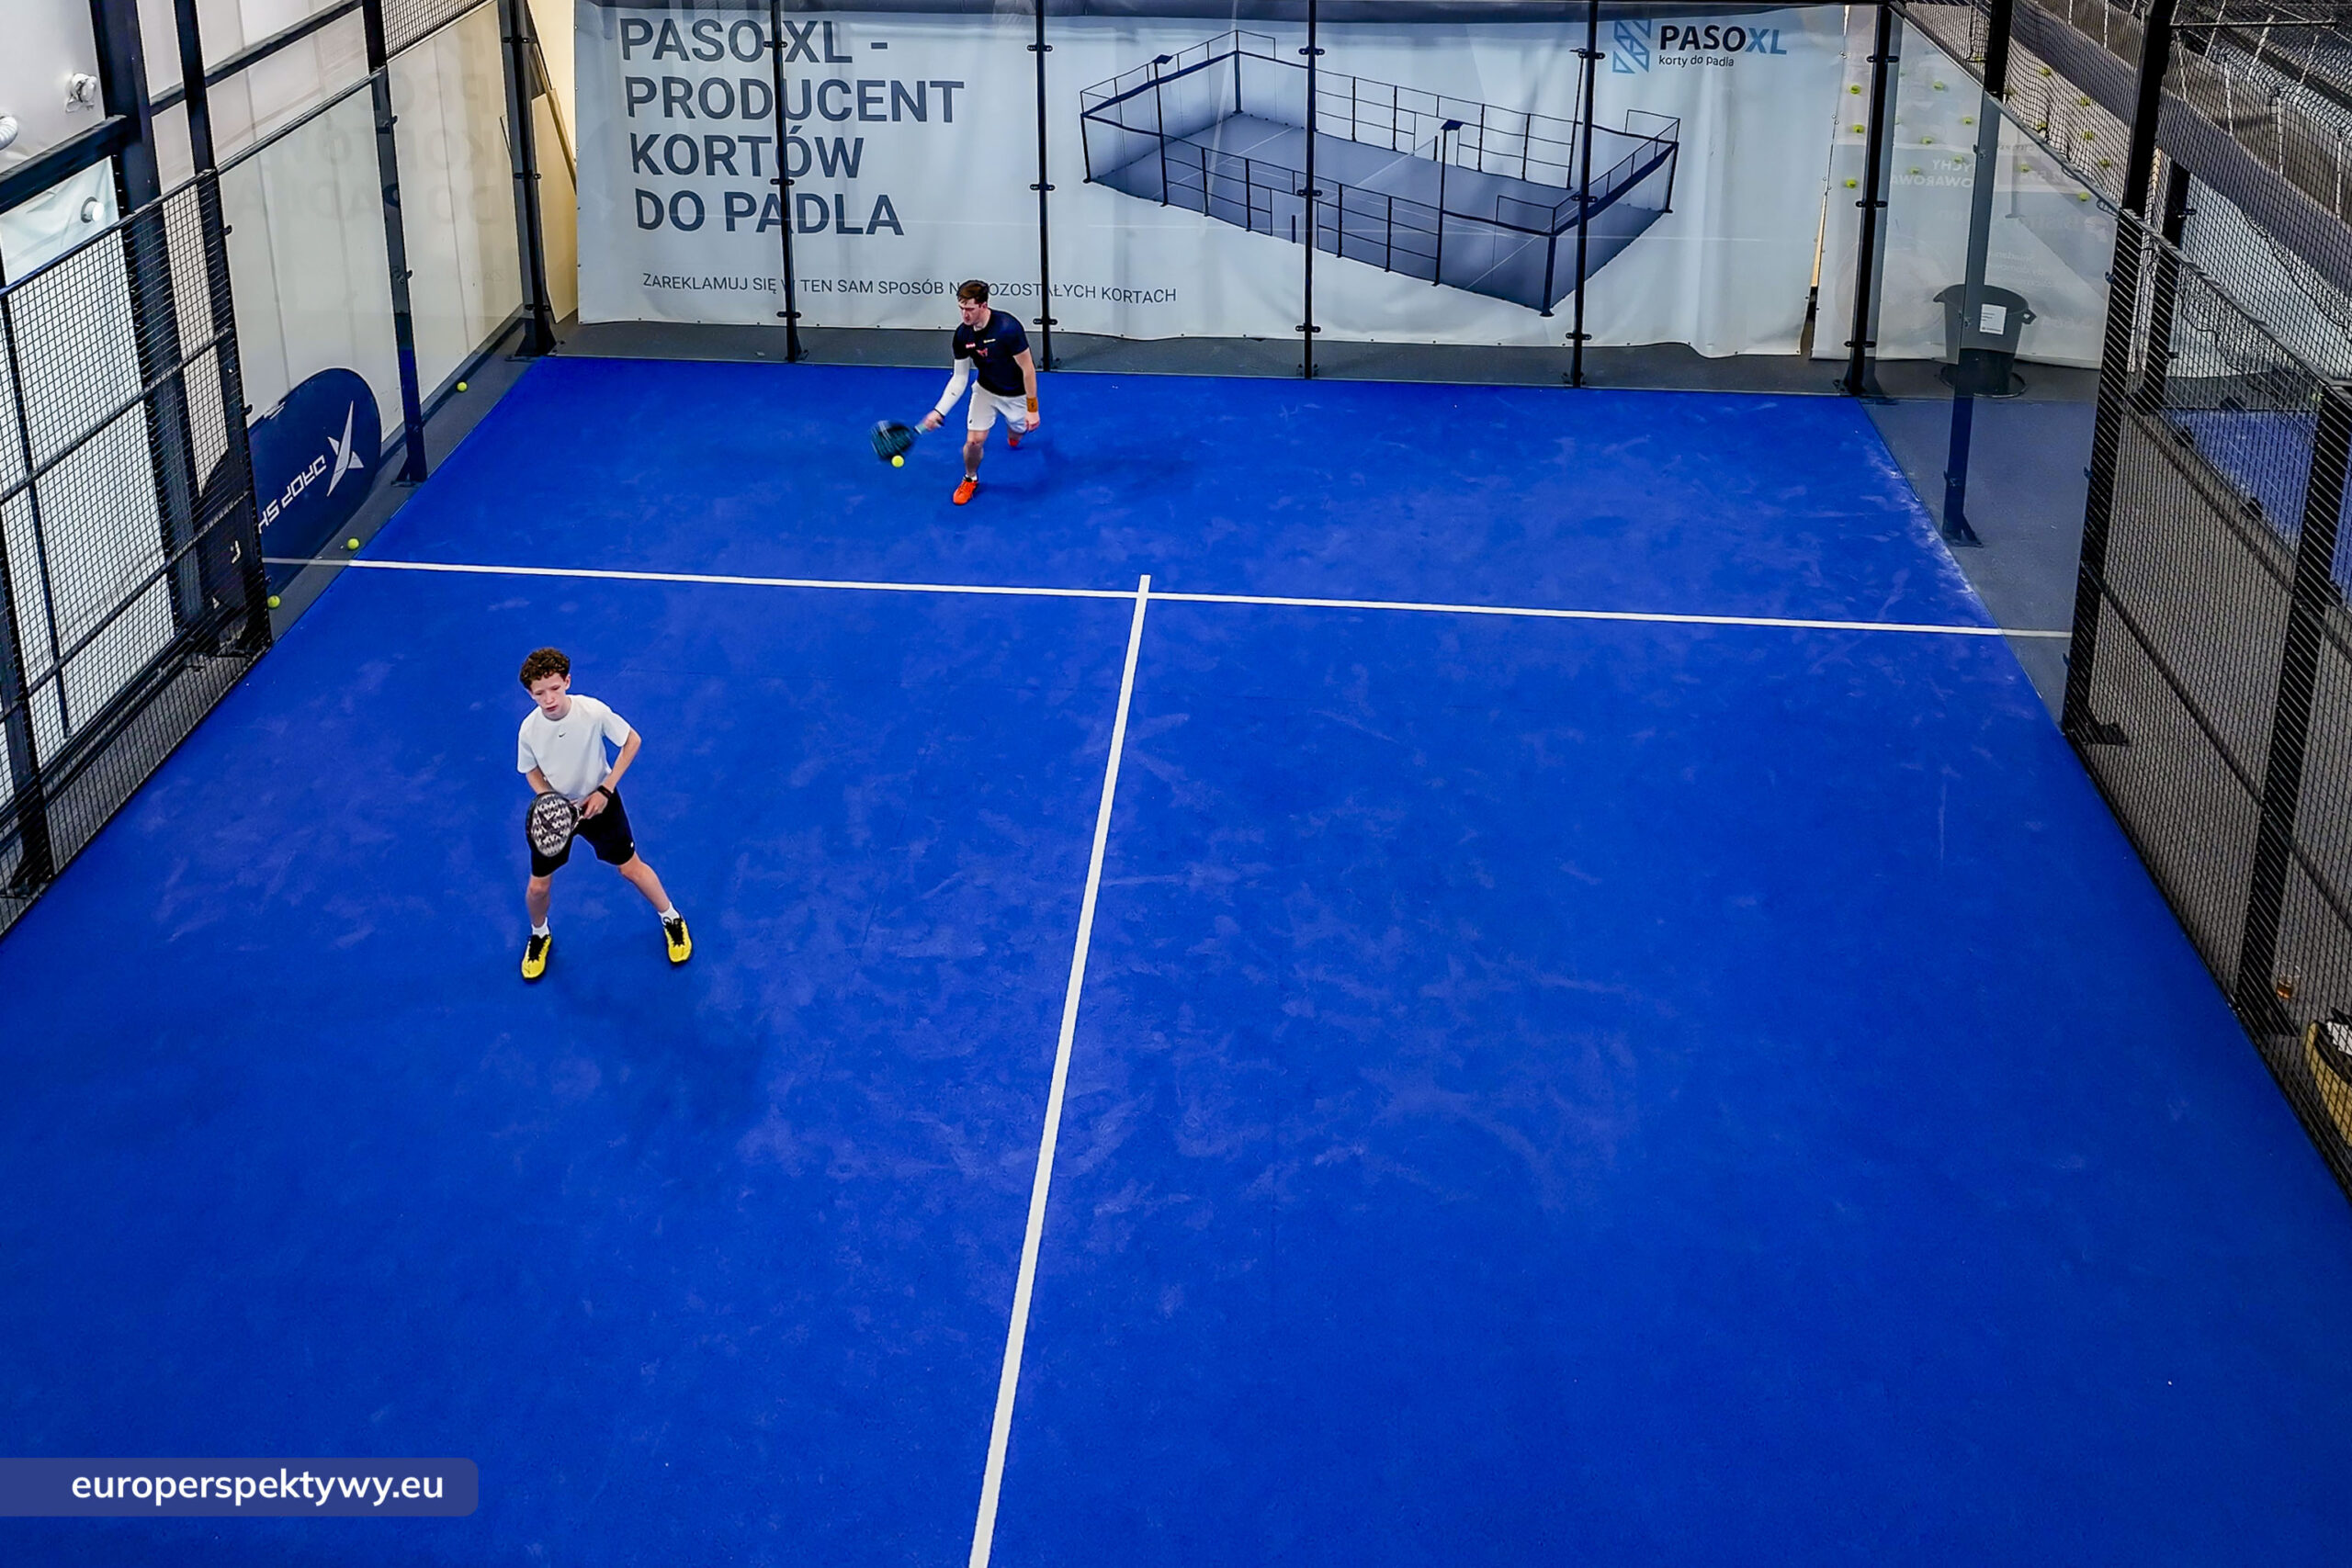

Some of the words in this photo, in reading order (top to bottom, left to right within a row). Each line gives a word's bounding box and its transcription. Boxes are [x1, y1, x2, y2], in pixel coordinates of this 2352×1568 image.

[620, 17, 764, 62] PASO
[784, 19, 853, 64] XL
[1658, 54, 1688, 68] korty
[1690, 55, 1703, 65] do
[1706, 56, 1735, 67] padla
[1659, 24, 1788, 55] PASOXL
[625, 75, 966, 124] PRODUCENT
[629, 125, 865, 179] KORTÓW
[635, 187, 706, 231] DO
[724, 191, 905, 236] PADLA
[642, 273, 749, 291] ZAREKLAMUJ
[752, 276, 777, 294] SIĘ
[800, 278, 833, 293] TEN
[837, 279, 874, 294] SAM
[877, 278, 944, 296] SPOSÓB
[988, 283, 1096, 299] OZOSTŁYCH
[1102, 286, 1177, 304] KORTACH
